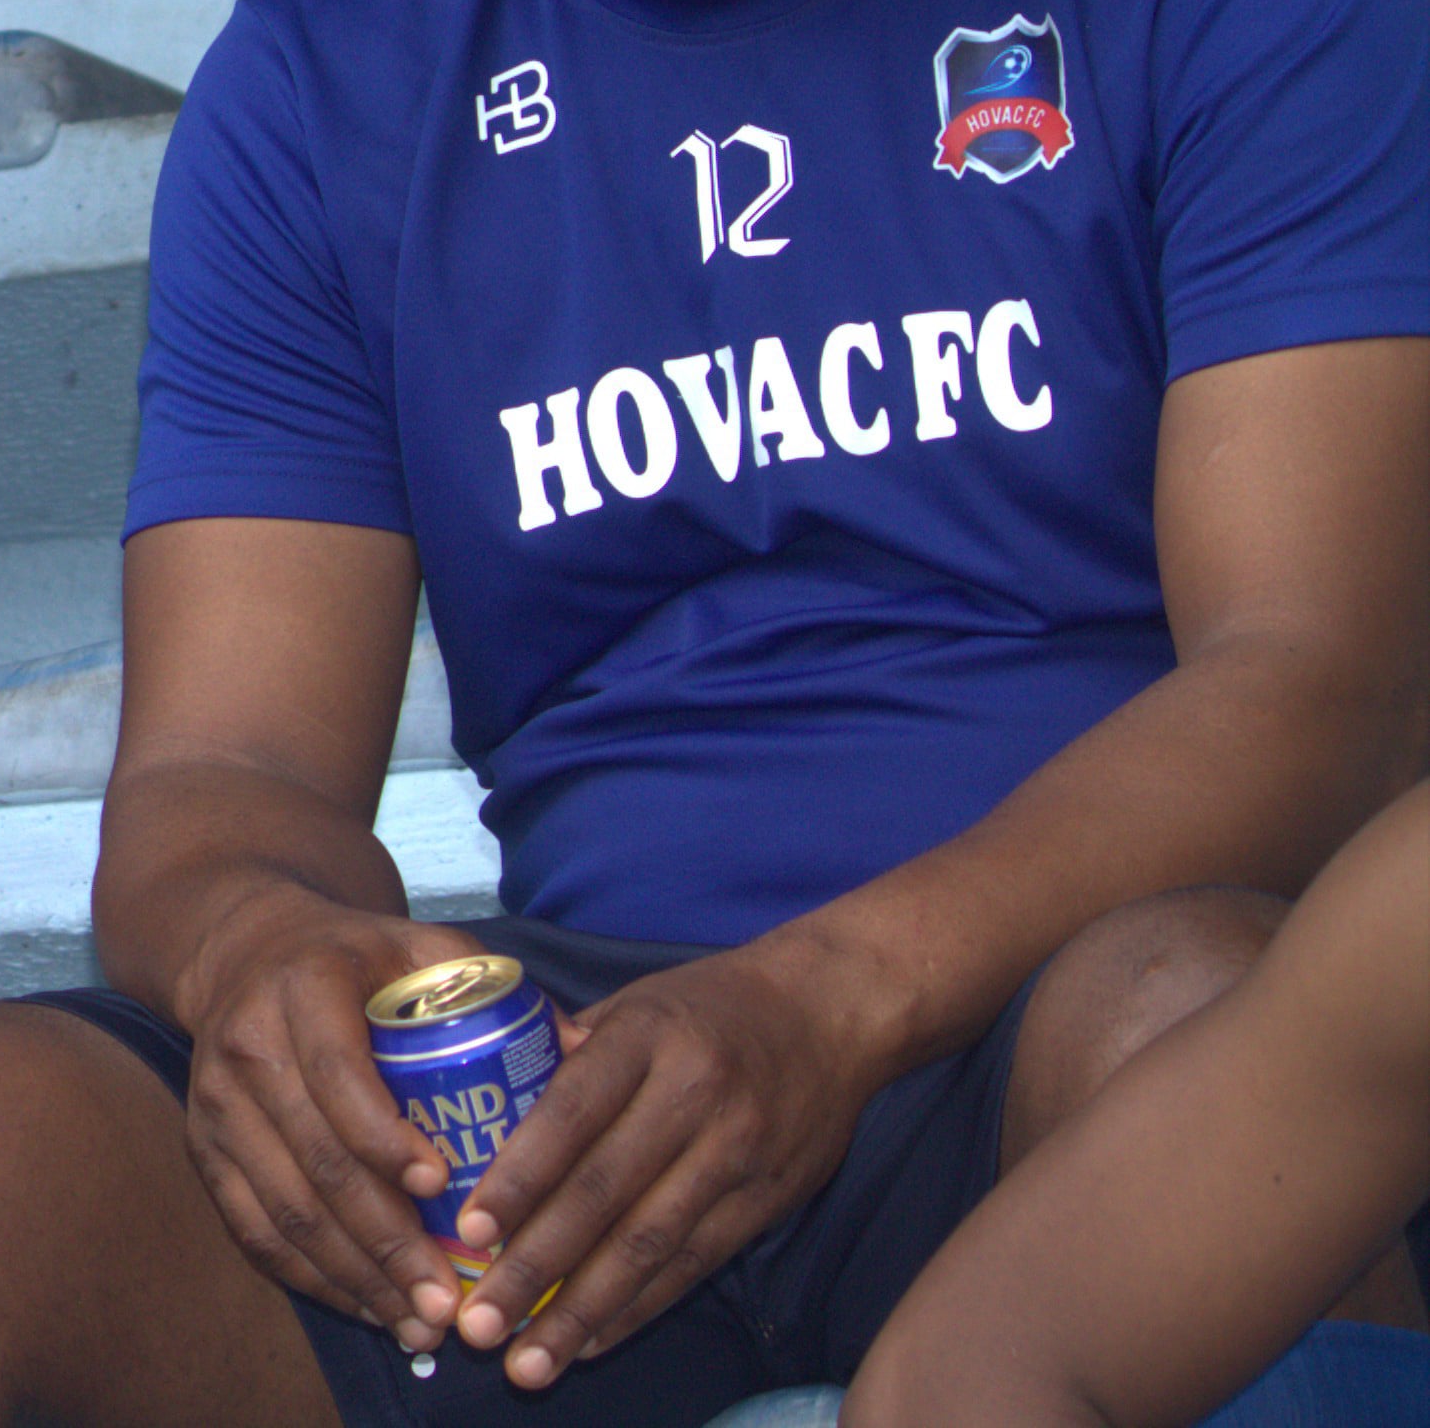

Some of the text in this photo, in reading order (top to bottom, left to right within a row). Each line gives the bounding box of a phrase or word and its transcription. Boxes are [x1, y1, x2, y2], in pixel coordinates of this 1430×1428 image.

[966, 105, 1046, 133] HOVAC FC
[670, 124, 793, 264] 12
[499, 298, 1053, 531] HOVAC FC
